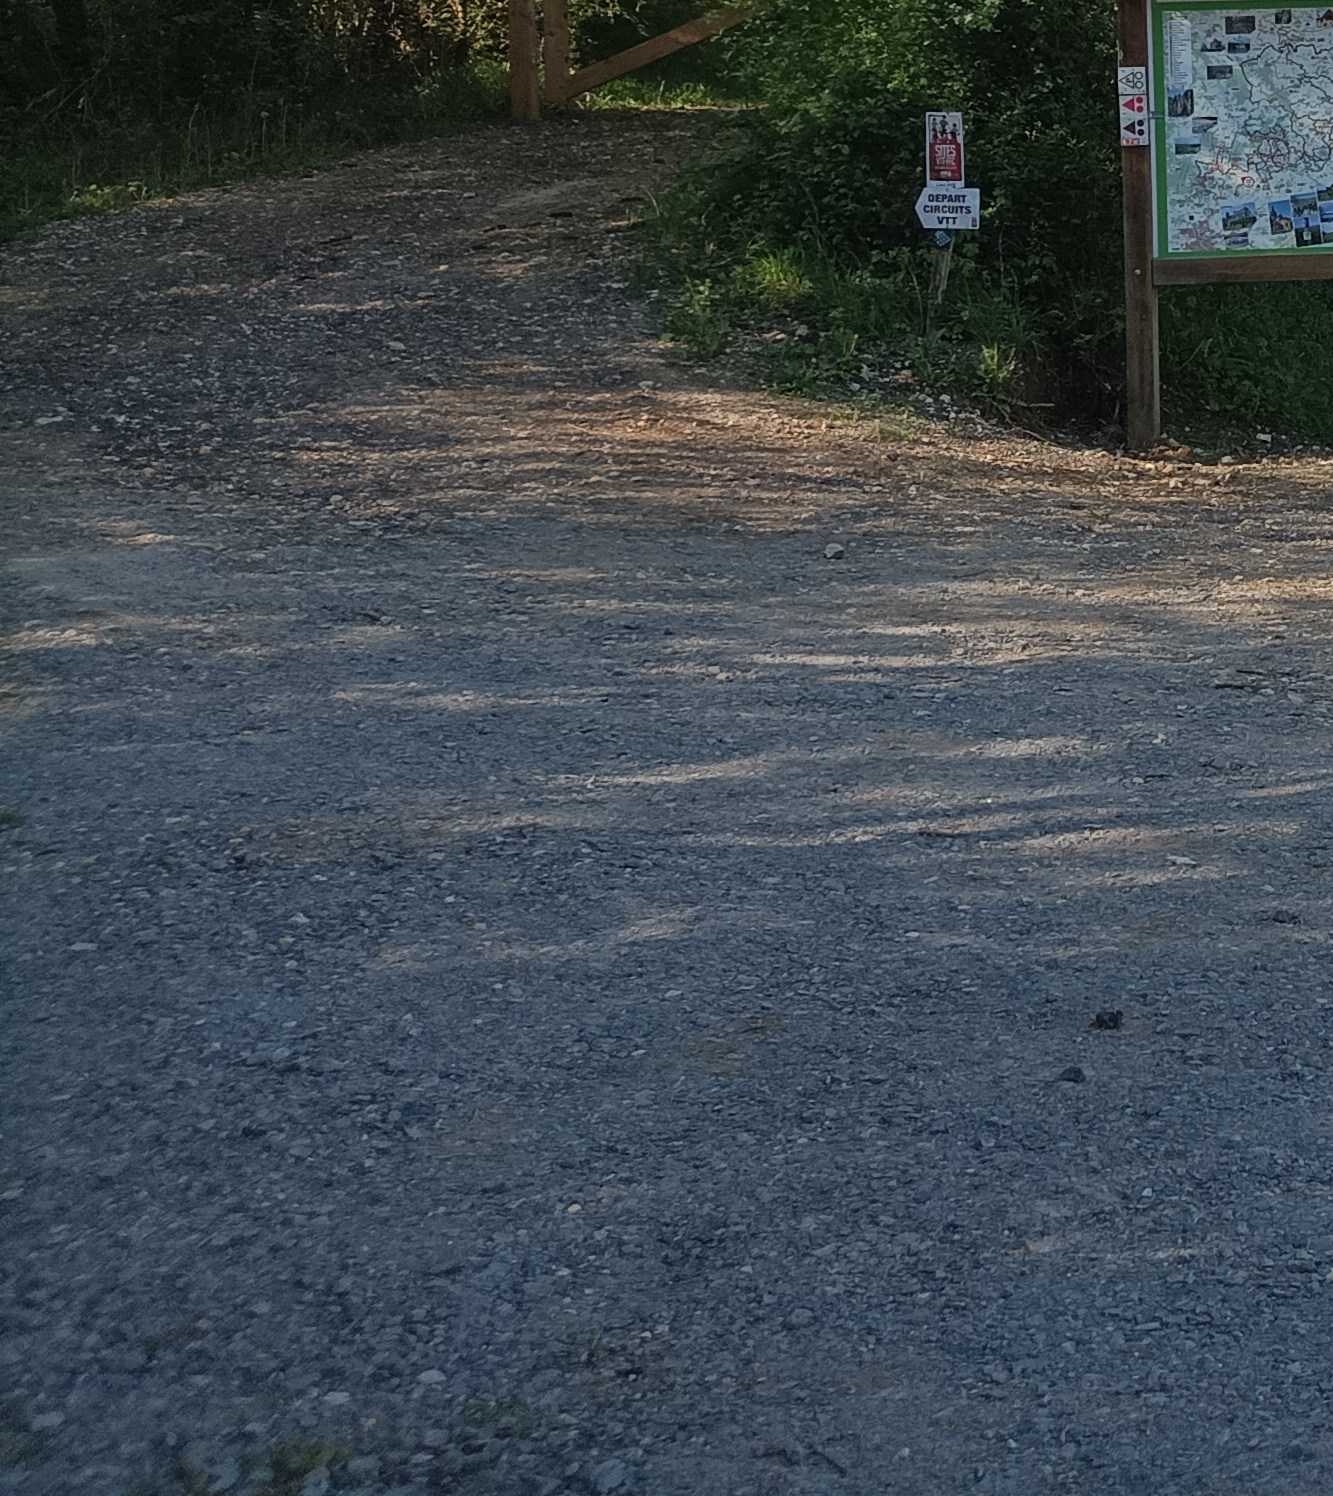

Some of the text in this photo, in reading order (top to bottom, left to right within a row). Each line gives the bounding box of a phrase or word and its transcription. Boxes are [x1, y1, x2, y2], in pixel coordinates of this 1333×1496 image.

[934, 144, 957, 157] SITES
[927, 193, 967, 203] DEPART
[923, 204, 972, 214] CIRCUITS
[936, 216, 958, 225] VTT
